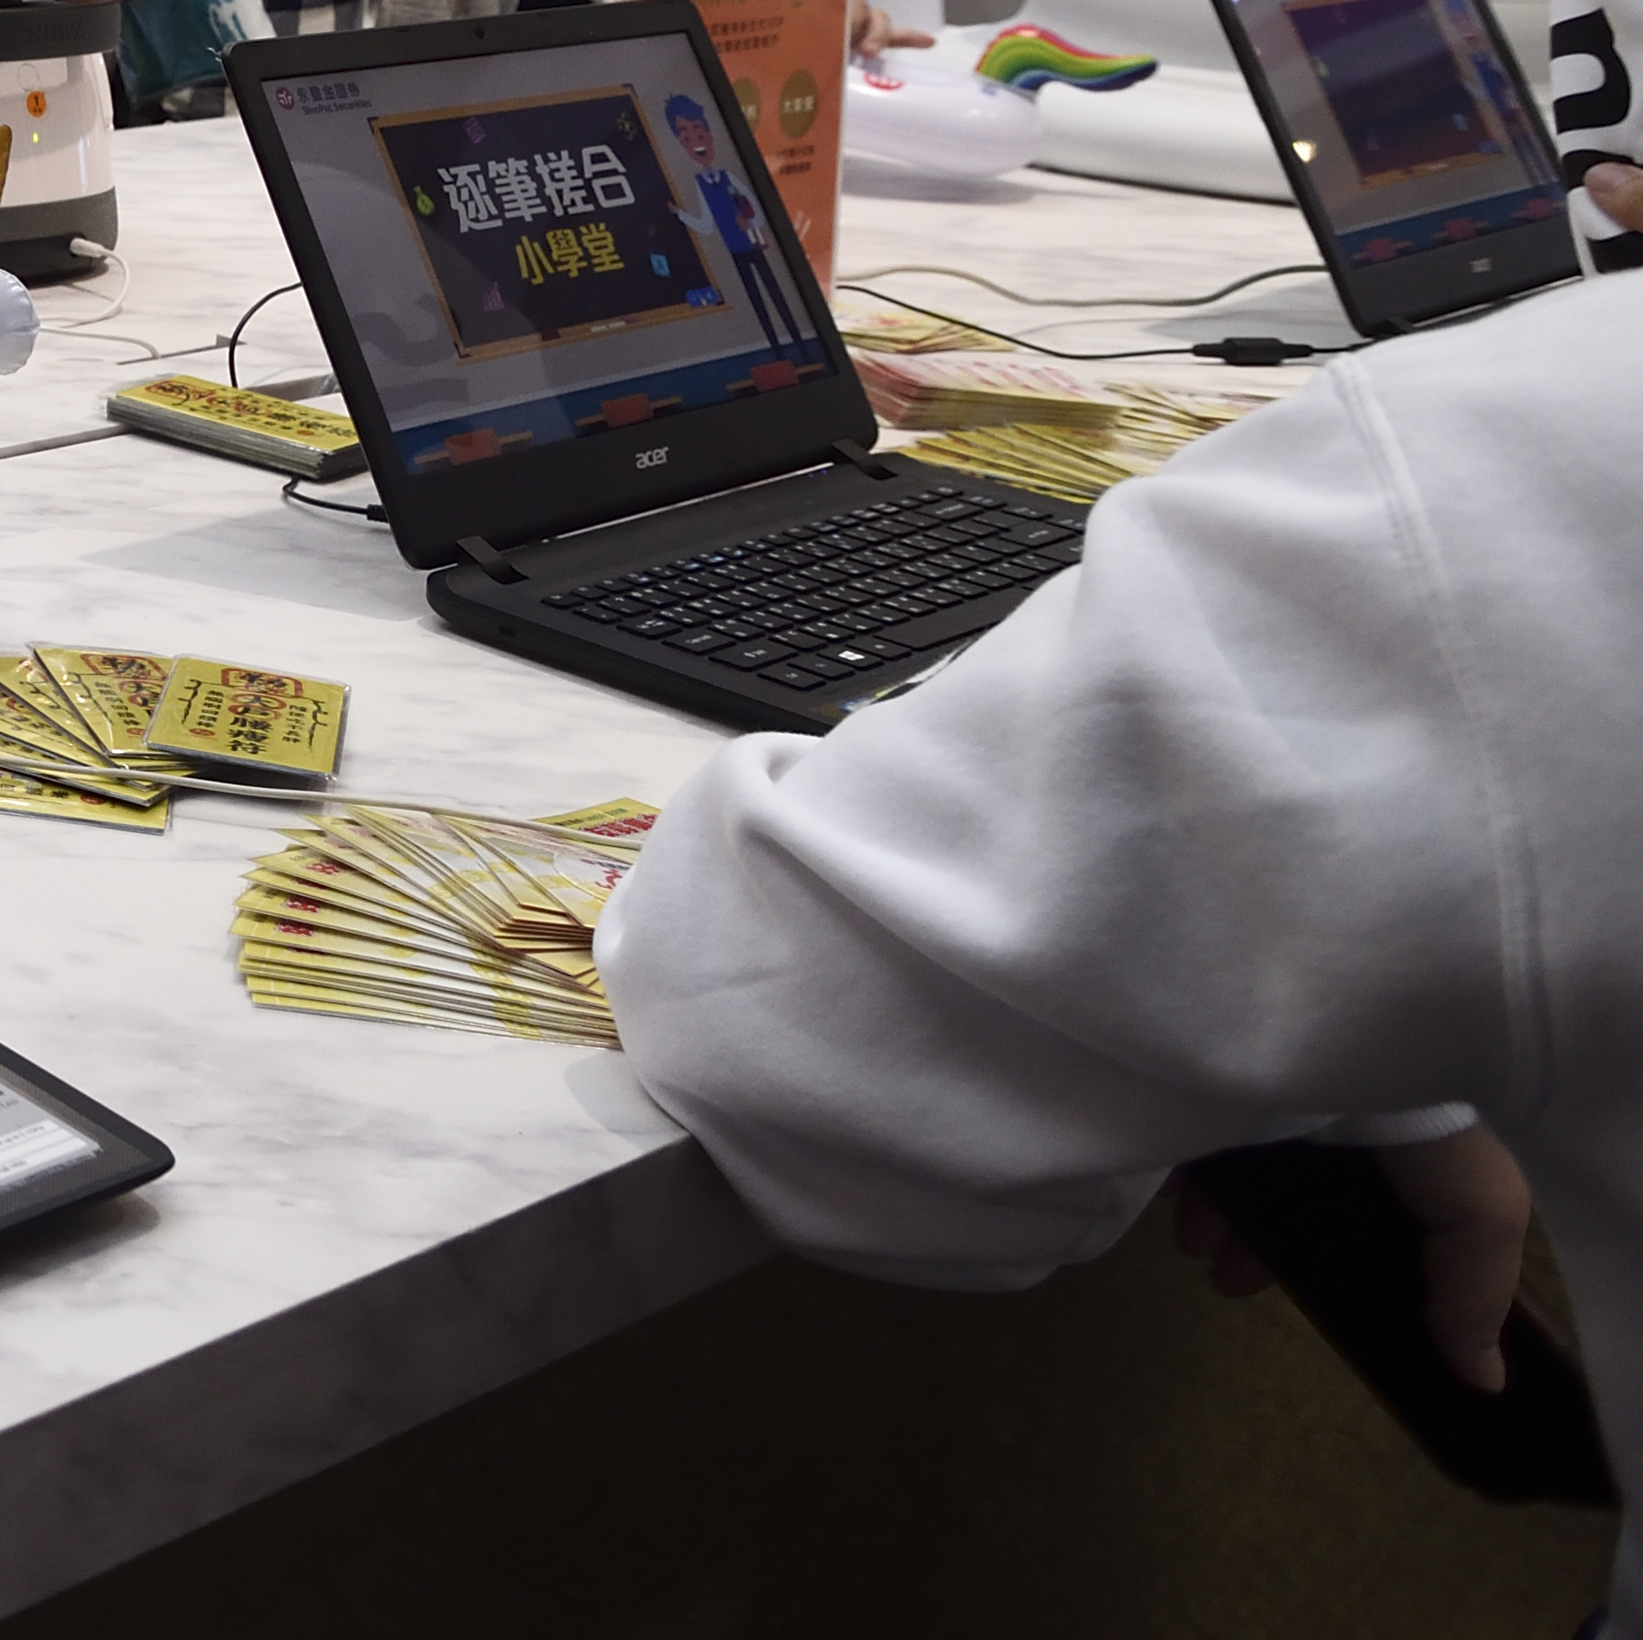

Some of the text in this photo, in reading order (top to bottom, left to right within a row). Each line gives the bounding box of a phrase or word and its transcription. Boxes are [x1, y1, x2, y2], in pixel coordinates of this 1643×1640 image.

[438, 143, 636, 234] 逐筆搓合
[516, 221, 624, 285] 小學堂
[635, 445, 670, 469] acer
